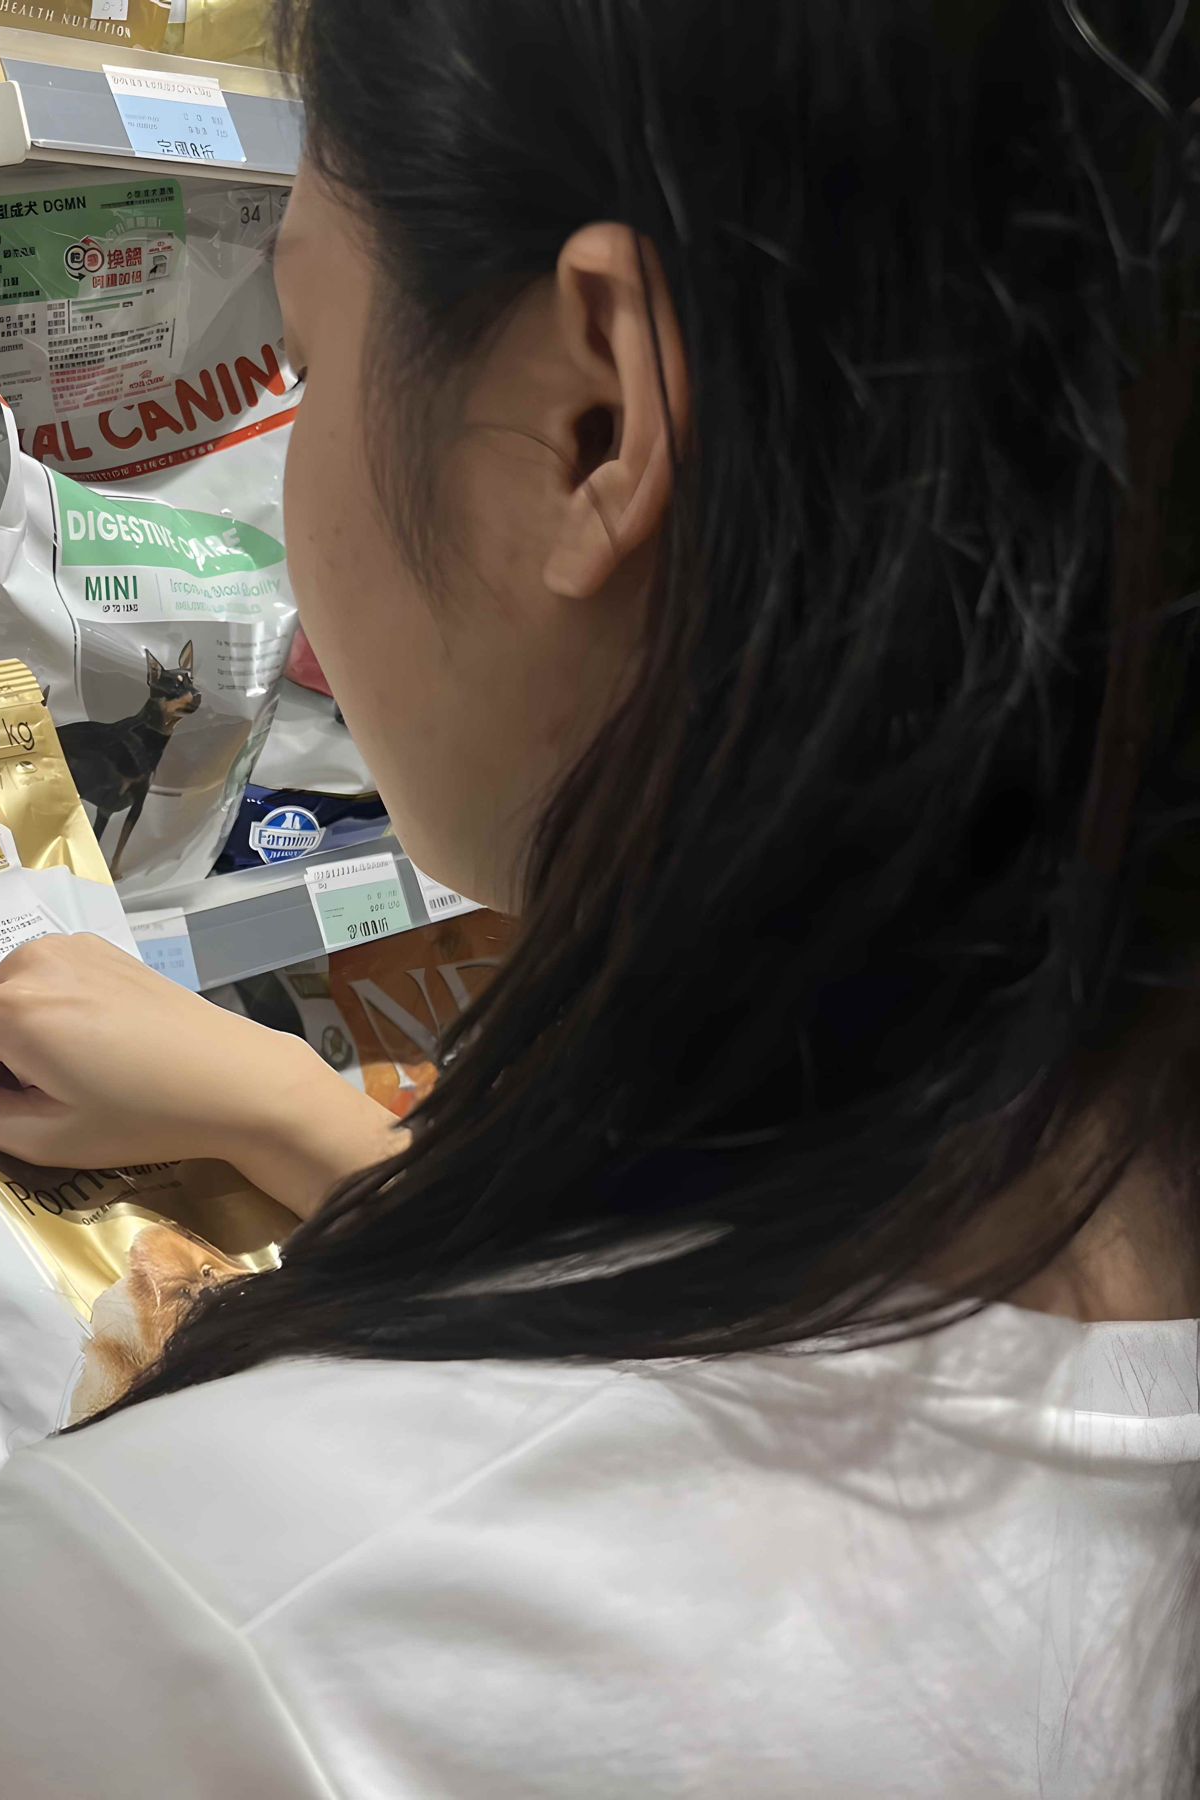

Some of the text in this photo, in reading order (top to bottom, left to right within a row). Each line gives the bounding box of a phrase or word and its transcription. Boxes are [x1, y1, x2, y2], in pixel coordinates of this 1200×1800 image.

[1, 4, 54, 23] HEALTH
[43, 195, 87, 214] DGMN
[240, 205, 261, 225] 34
[19, 421, 93, 463] AL
[99, 343, 285, 449] CANIN
[67, 509, 180, 553] DIGESTIVE
[85, 575, 139, 601] MINI
[2, 718, 36, 751] kg
